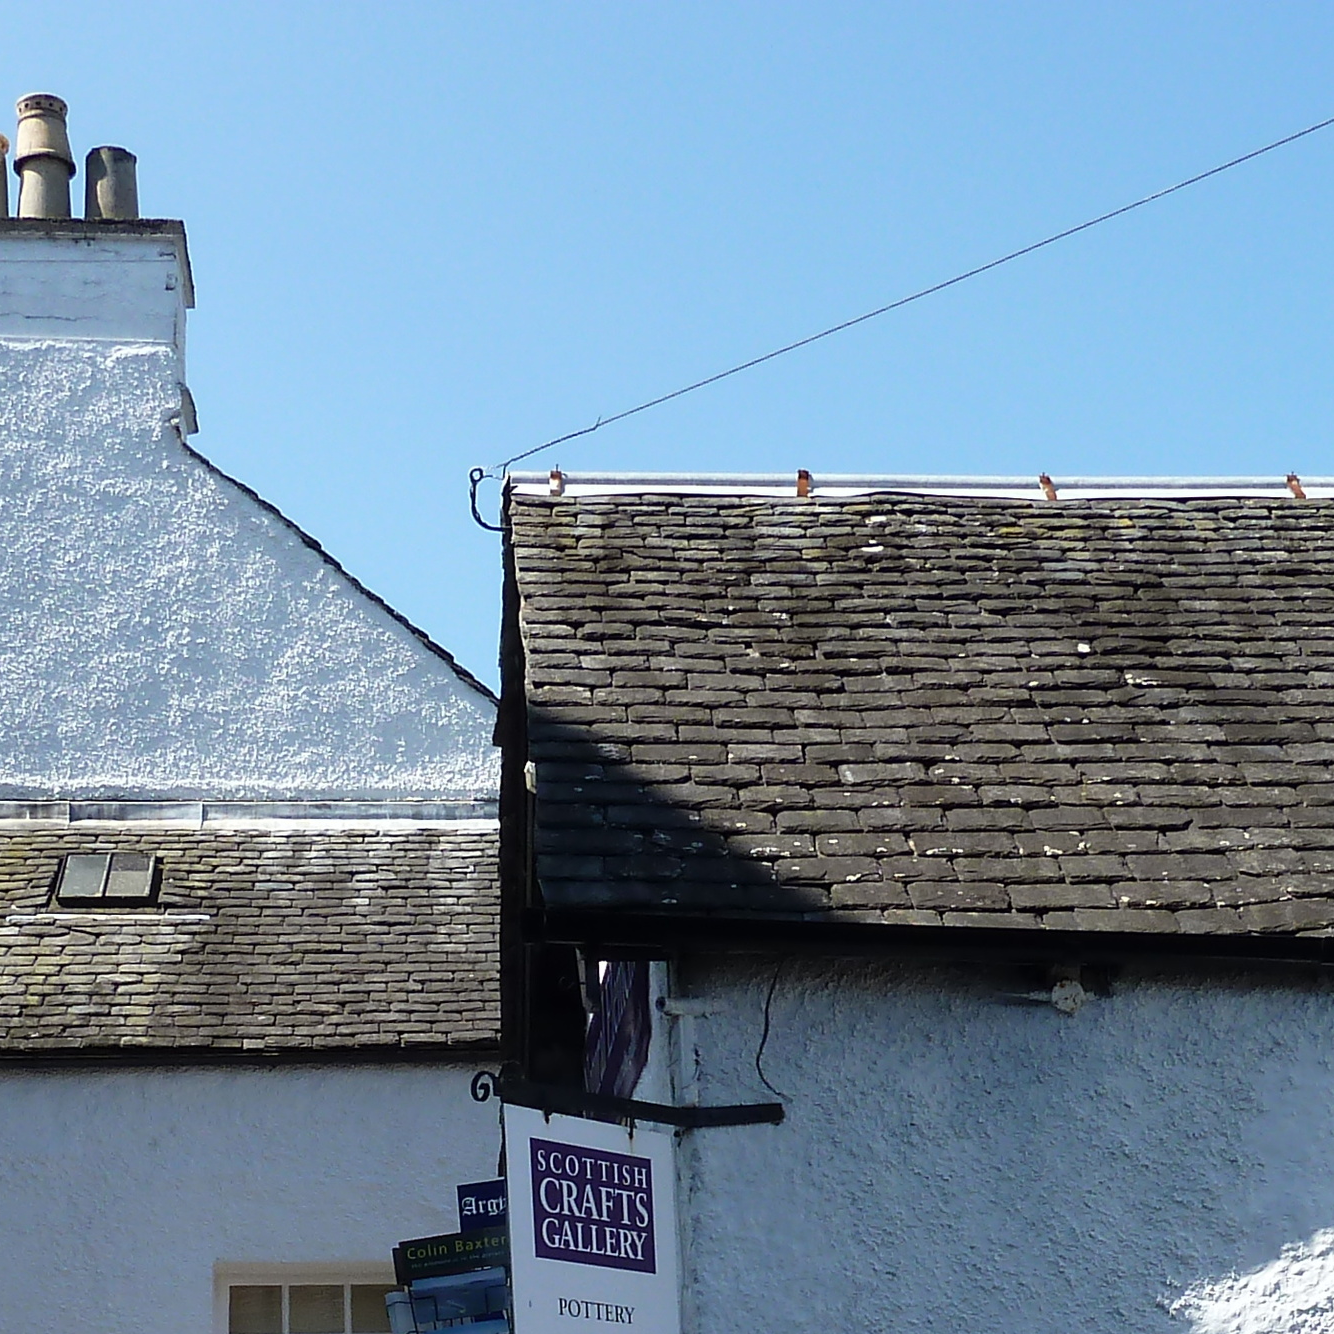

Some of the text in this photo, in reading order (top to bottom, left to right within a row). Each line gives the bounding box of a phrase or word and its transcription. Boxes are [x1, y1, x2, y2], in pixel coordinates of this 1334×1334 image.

[537, 1149, 648, 1189] SCOTTISH
[539, 1177, 649, 1228] CRAFTS
[407, 1244, 448, 1260] Colin
[455, 1235, 507, 1253] Baxter
[541, 1217, 648, 1260] GALLERY
[558, 1297, 635, 1325] POTTERY
